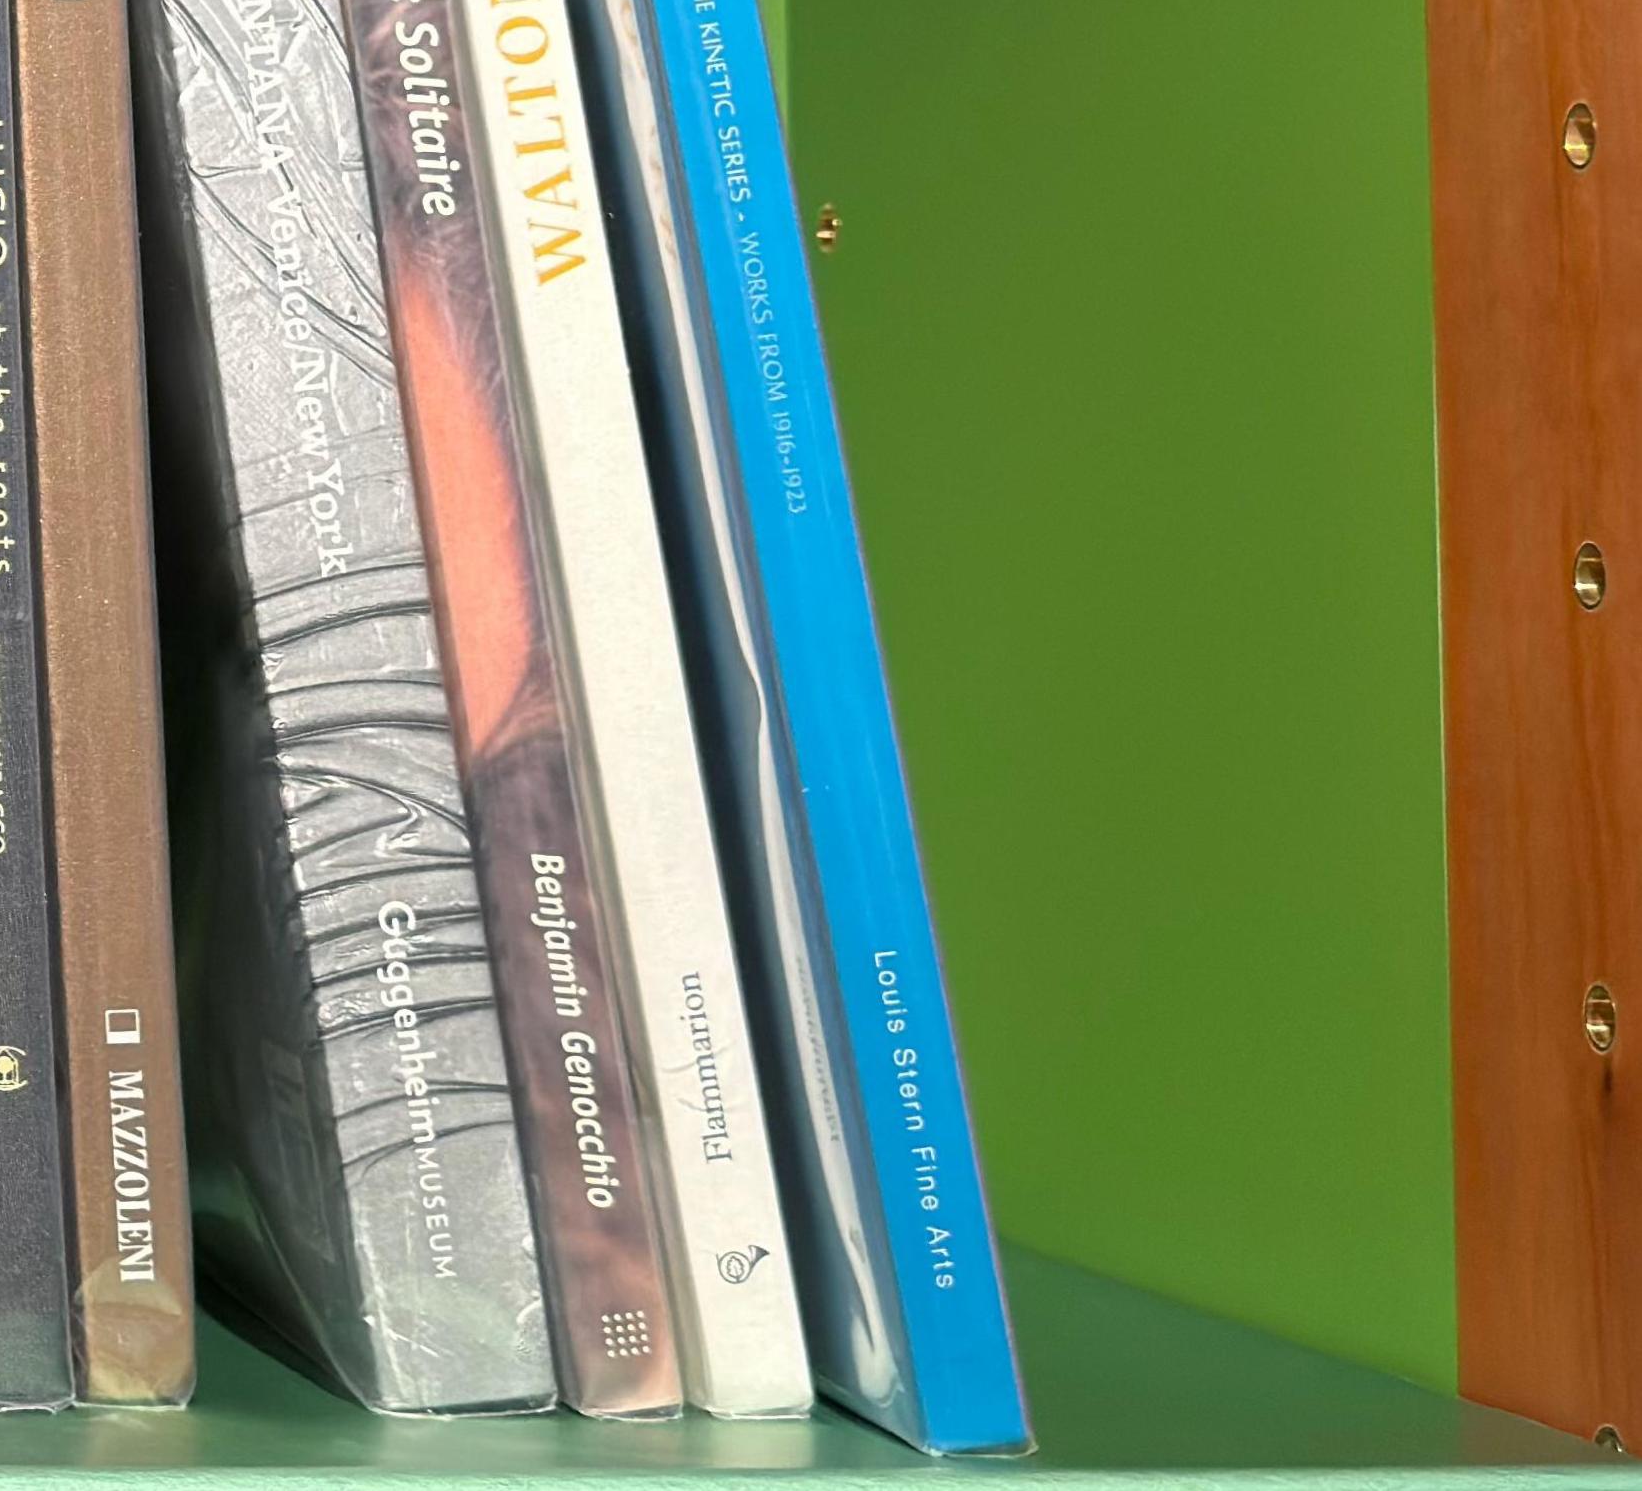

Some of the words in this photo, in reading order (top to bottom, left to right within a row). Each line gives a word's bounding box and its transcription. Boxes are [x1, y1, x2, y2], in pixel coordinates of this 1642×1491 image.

[699, 21, 736, 121] KINETIC
[394, 19, 457, 219] Solitaire
[717, 125, 753, 204] SERIES
[739, 231, 774, 326] WORKS
[757, 332, 788, 401] FROM
[305, 458, 356, 578] York
[530, 851, 584, 1019] Benjamin
[561, 1029, 619, 1209] Genocchio
[873, 949, 906, 1035] Louis
[679, 971, 733, 1164] Flammarion
[891, 1047, 924, 1133] Stern
[107, 1071, 156, 1283] MAZZOLENI
[910, 1144, 940, 1213] Fine
[924, 1224, 956, 1290] Arts
